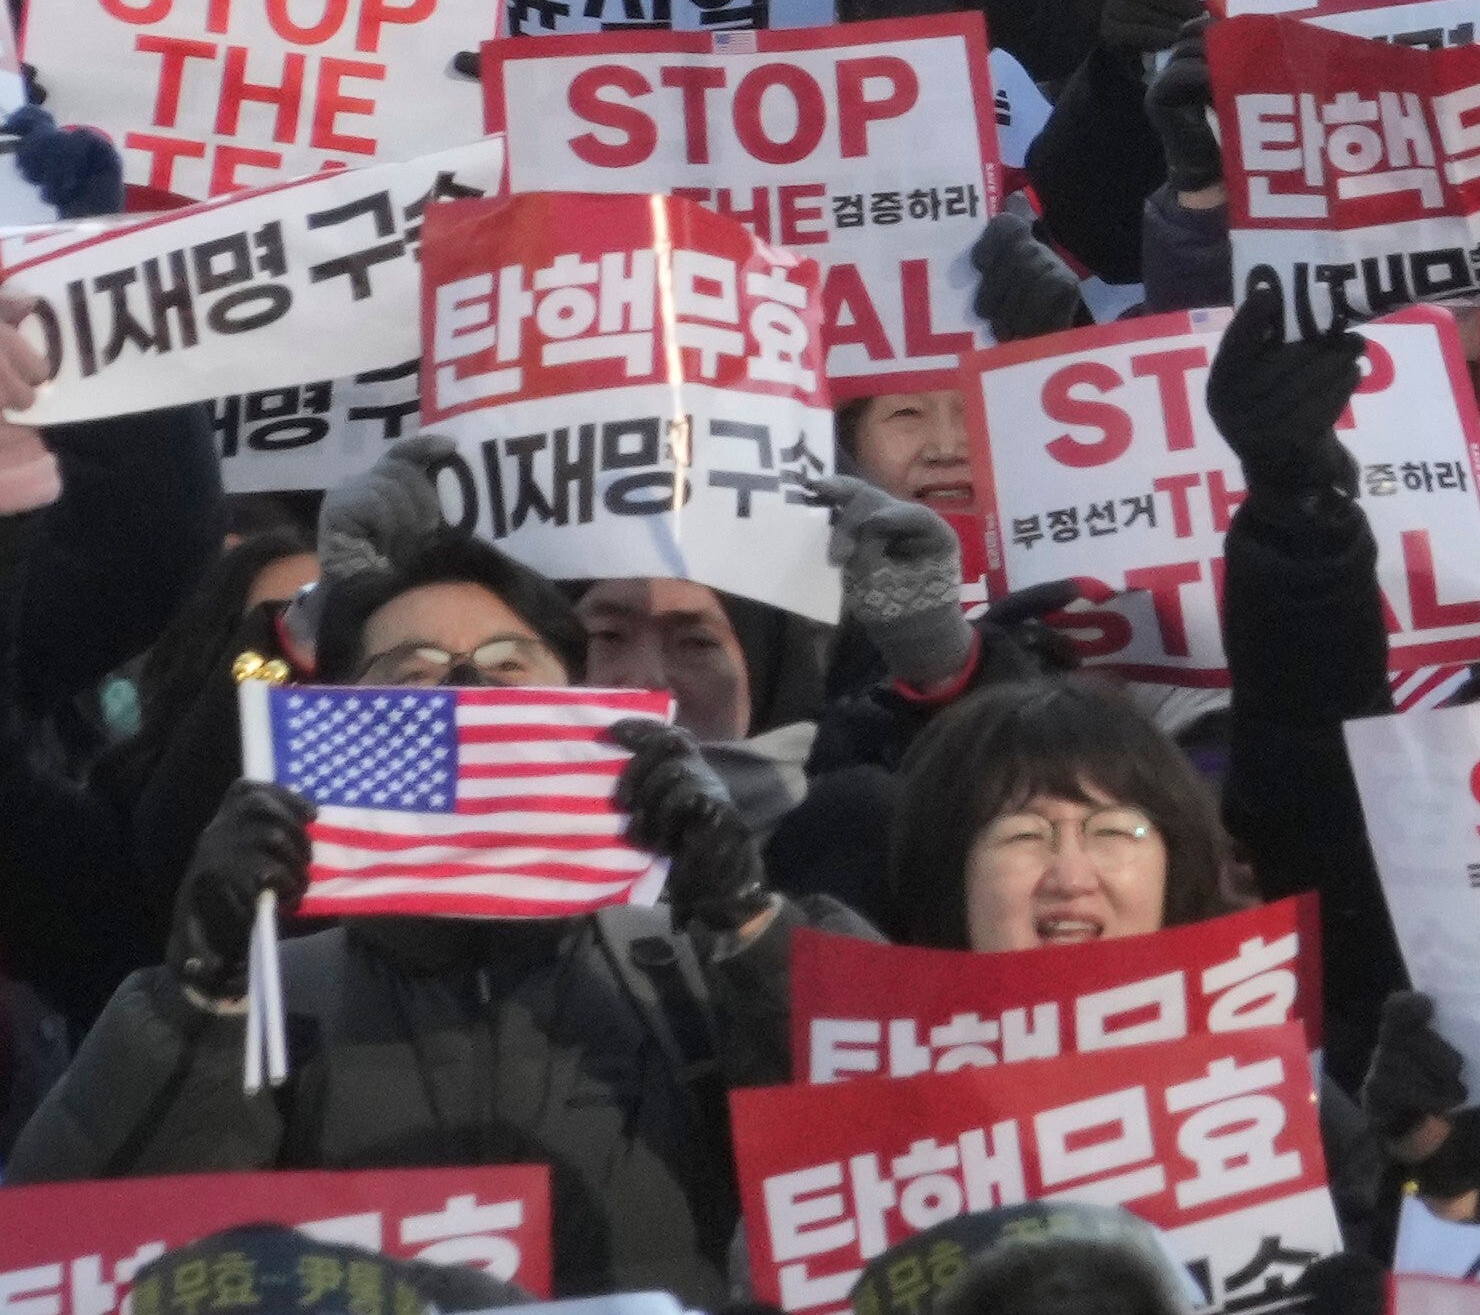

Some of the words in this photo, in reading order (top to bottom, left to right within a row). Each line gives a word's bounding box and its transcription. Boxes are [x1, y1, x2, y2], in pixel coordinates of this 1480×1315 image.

[134, 34, 387, 155] THE
[566, 55, 920, 167] STOP
[832, 186, 979, 229] 검증하라
[432, 246, 820, 413] 탄핵무효
[1013, 496, 1156, 546] 부정선거
